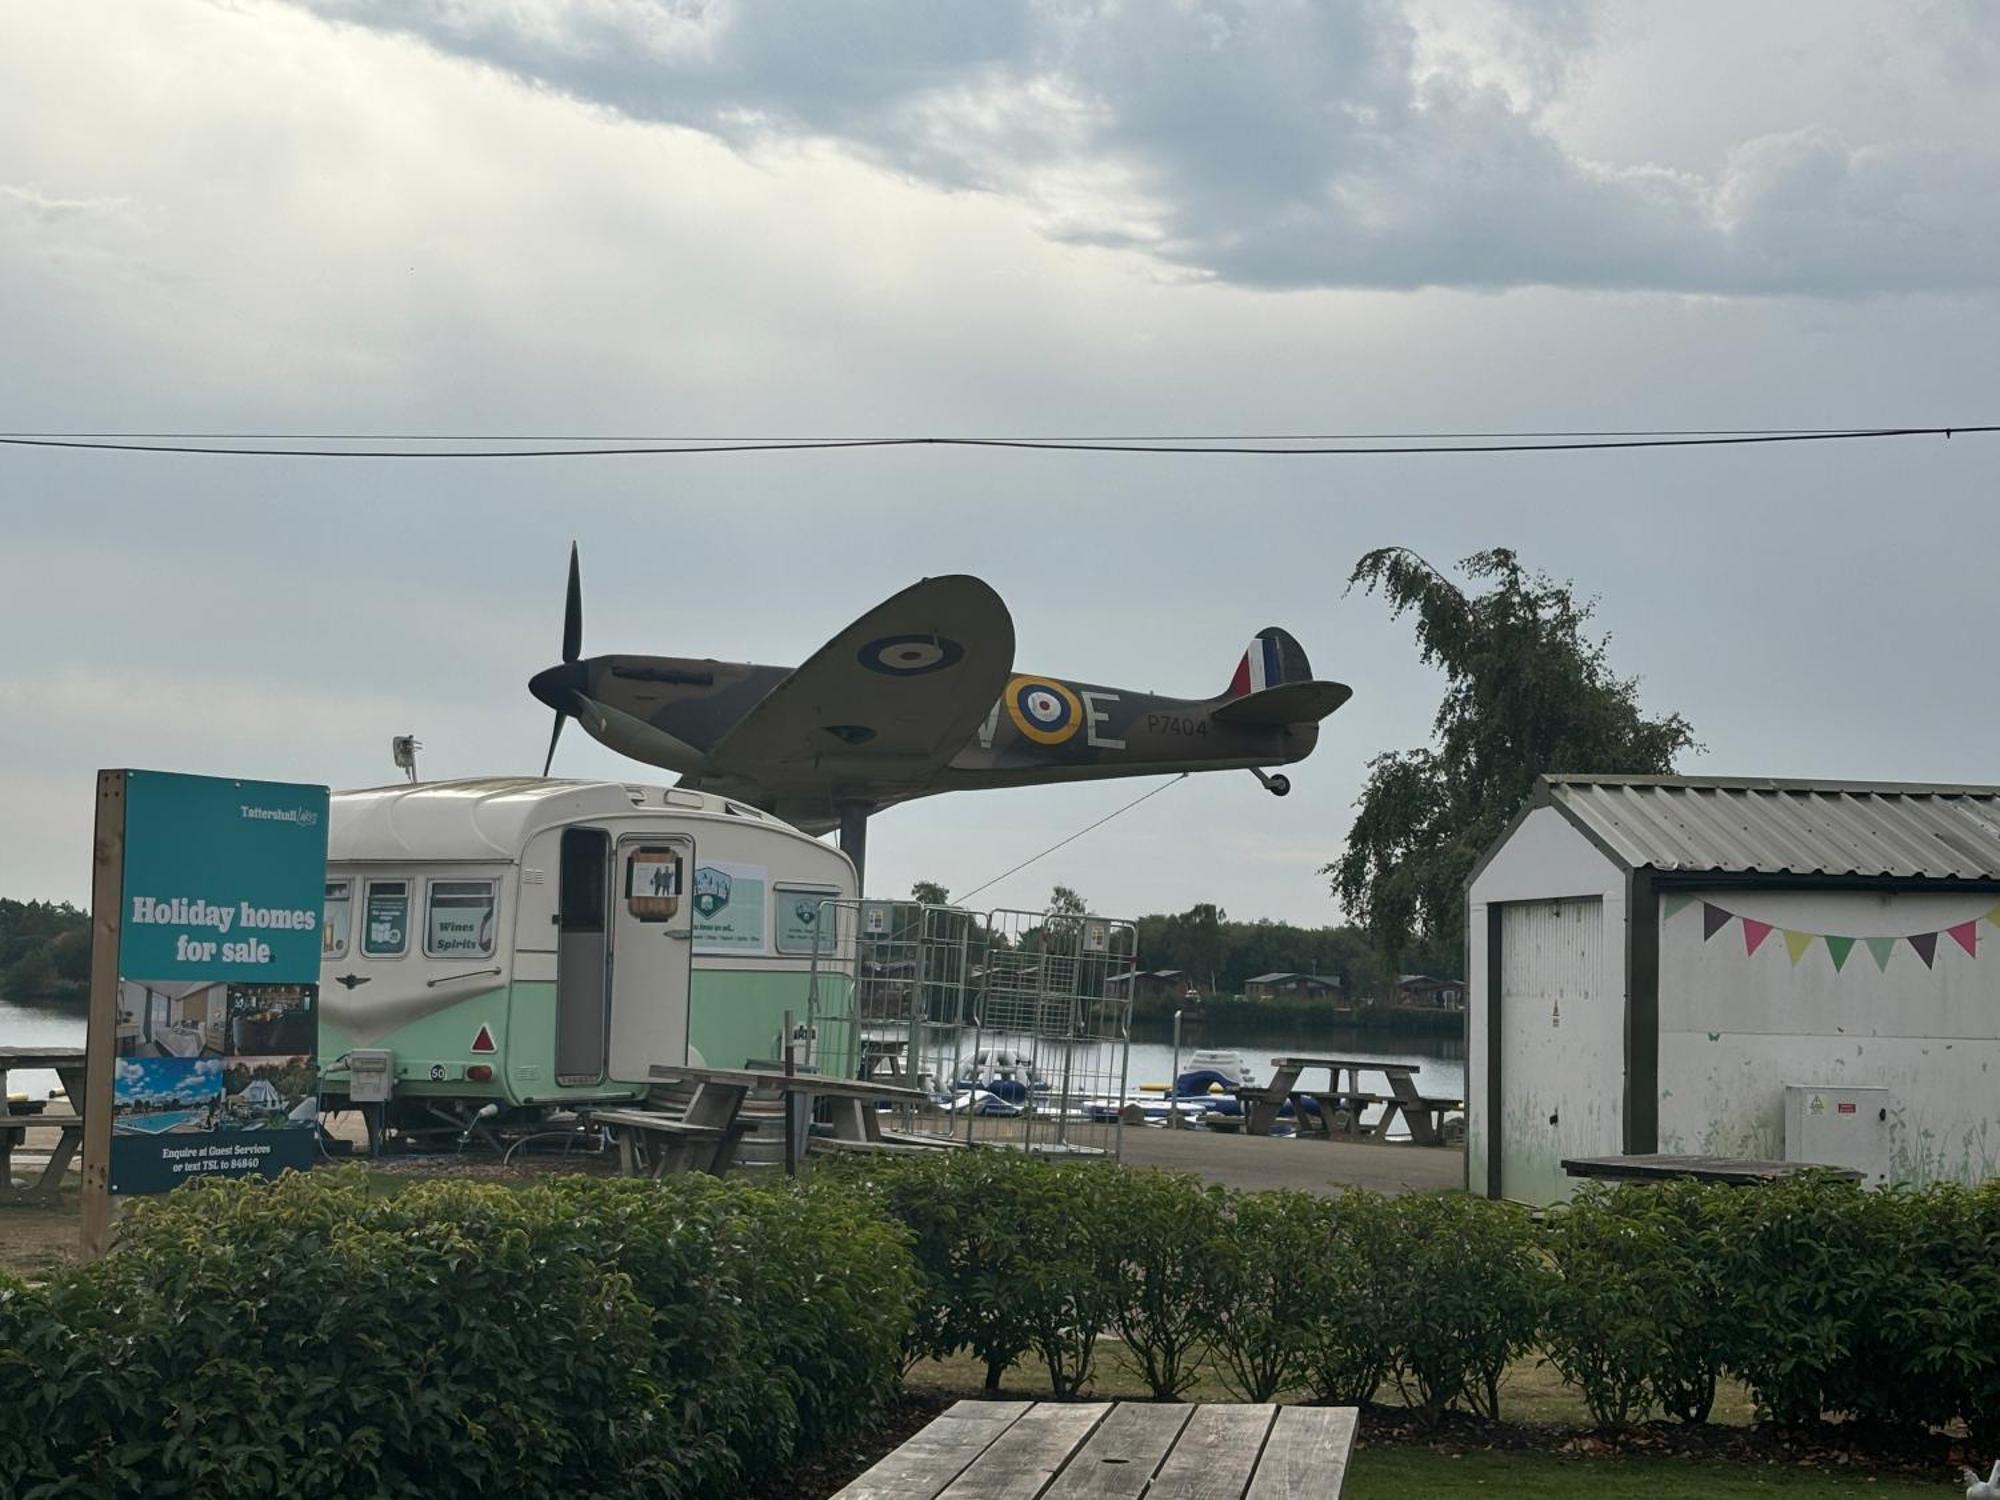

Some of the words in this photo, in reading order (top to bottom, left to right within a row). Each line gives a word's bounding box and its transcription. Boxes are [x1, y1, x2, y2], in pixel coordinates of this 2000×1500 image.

[1081, 691, 1126, 749] E
[1148, 714, 1207, 737] P7404
[240, 805, 297, 821] Tattershall
[132, 896, 235, 933] Holiday
[239, 902, 317, 930] homes
[440, 921, 475, 932] Wines
[176, 934, 217, 962] for
[437, 939, 477, 951] Spirits
[432, 1068, 445, 1079] 50
[162, 1147, 198, 1160] Enquire
[199, 1147, 207, 1157] at
[209, 1145, 233, 1156] Guest
[234, 1143, 271, 1155] Services
[173, 1163, 184, 1172] or
[185, 1161, 201, 1172] text
[202, 1160, 219, 1171] TSL
[220, 1159, 230, 1170] to
[231, 1158, 260, 1169] 84840
